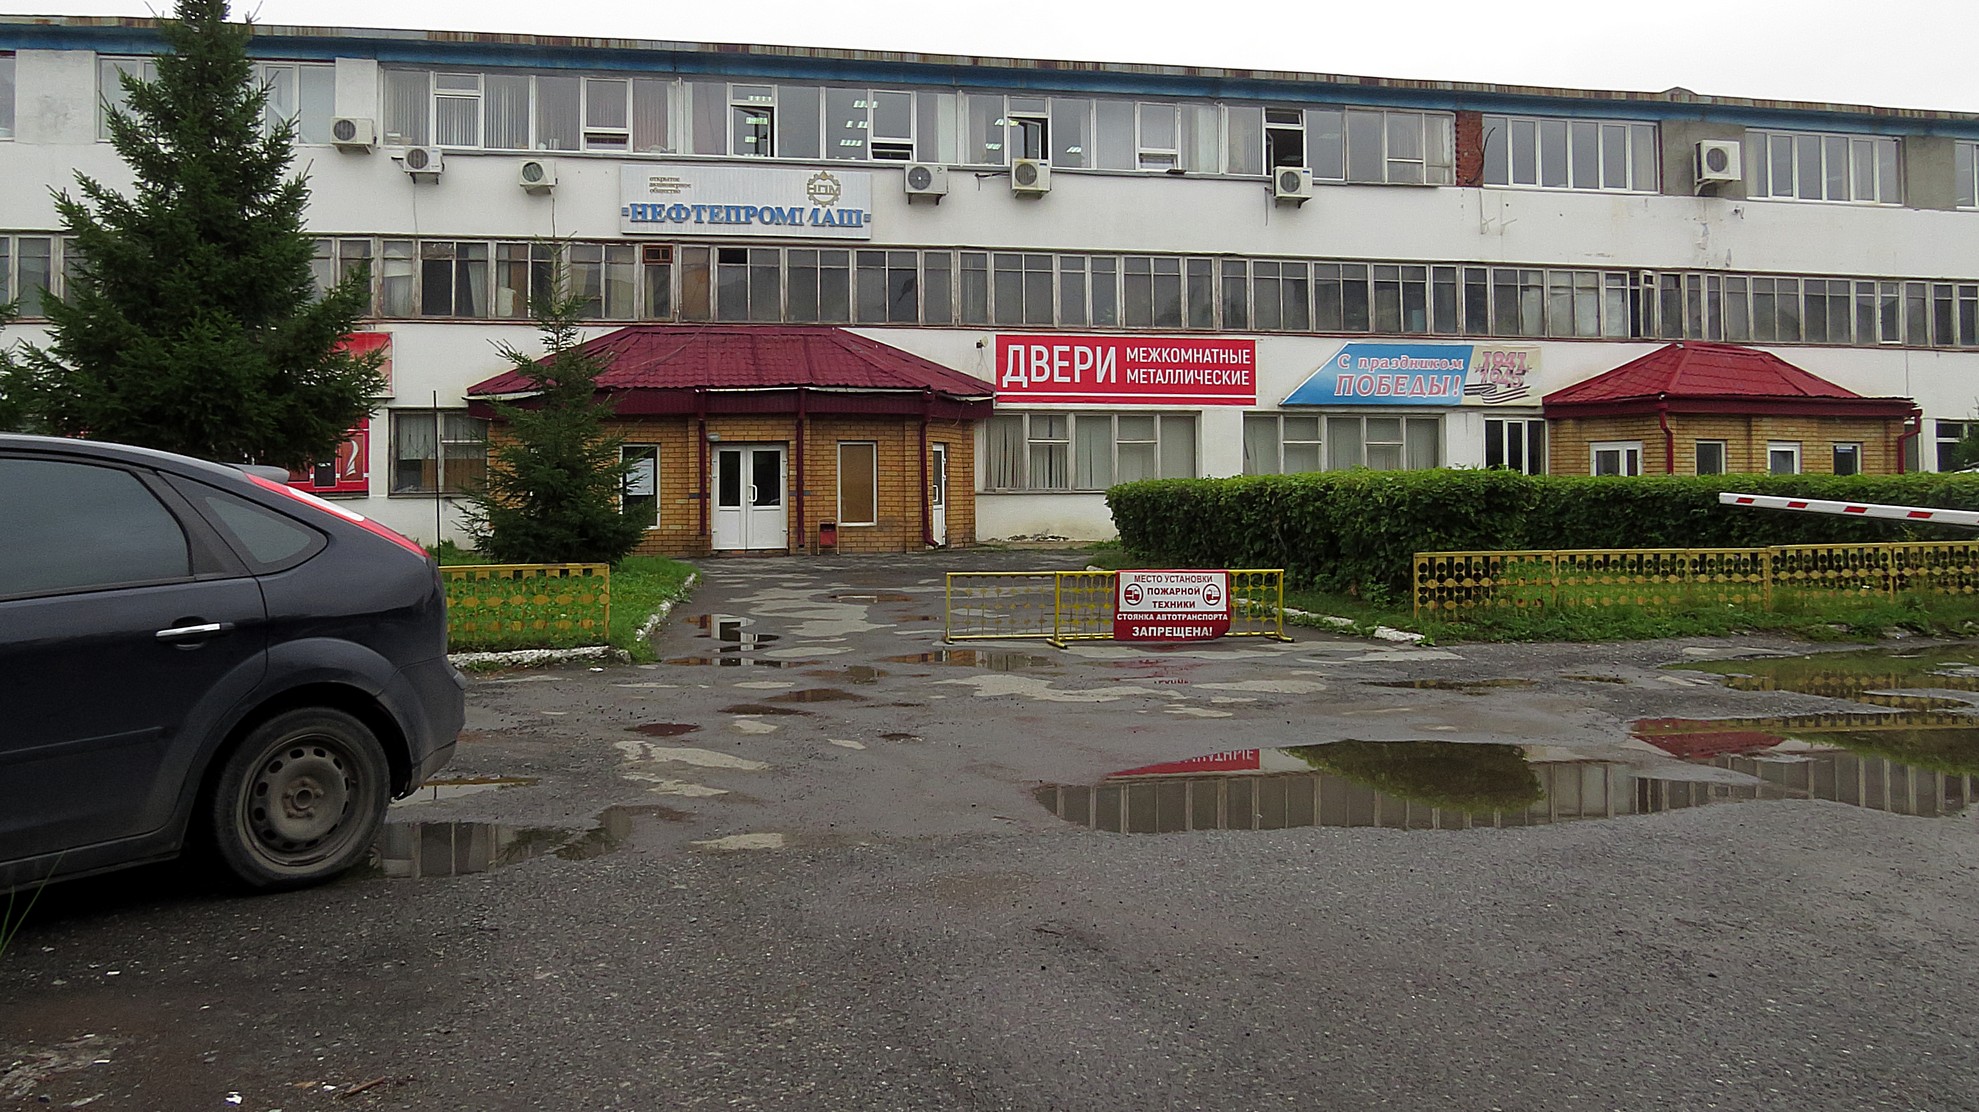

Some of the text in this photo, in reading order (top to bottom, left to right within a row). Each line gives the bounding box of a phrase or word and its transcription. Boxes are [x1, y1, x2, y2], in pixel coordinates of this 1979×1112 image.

[1126, 347, 1251, 364] МЕЖКОМНАТНЫЕ
[1002, 344, 1116, 388] ДВЕРИ
[1357, 354, 1464, 372] праздником
[1126, 368, 1250, 386] МЕТАЛЛИЧЕСКИЕ
[1333, 375, 1462, 397] ПОБЕДЫ!
[1134, 575, 1213, 583] МЕСТО УСТАНОВКИ
[1147, 586, 1201, 595] ПОЖАРНОЙ
[1152, 600, 1196, 609] ТЕХНИКИ
[1116, 613, 1228, 621] СТОЯНКА АВТОТРАНСПОРТА
[1132, 626, 1213, 638] ЗАПРЕЩЕНА!
